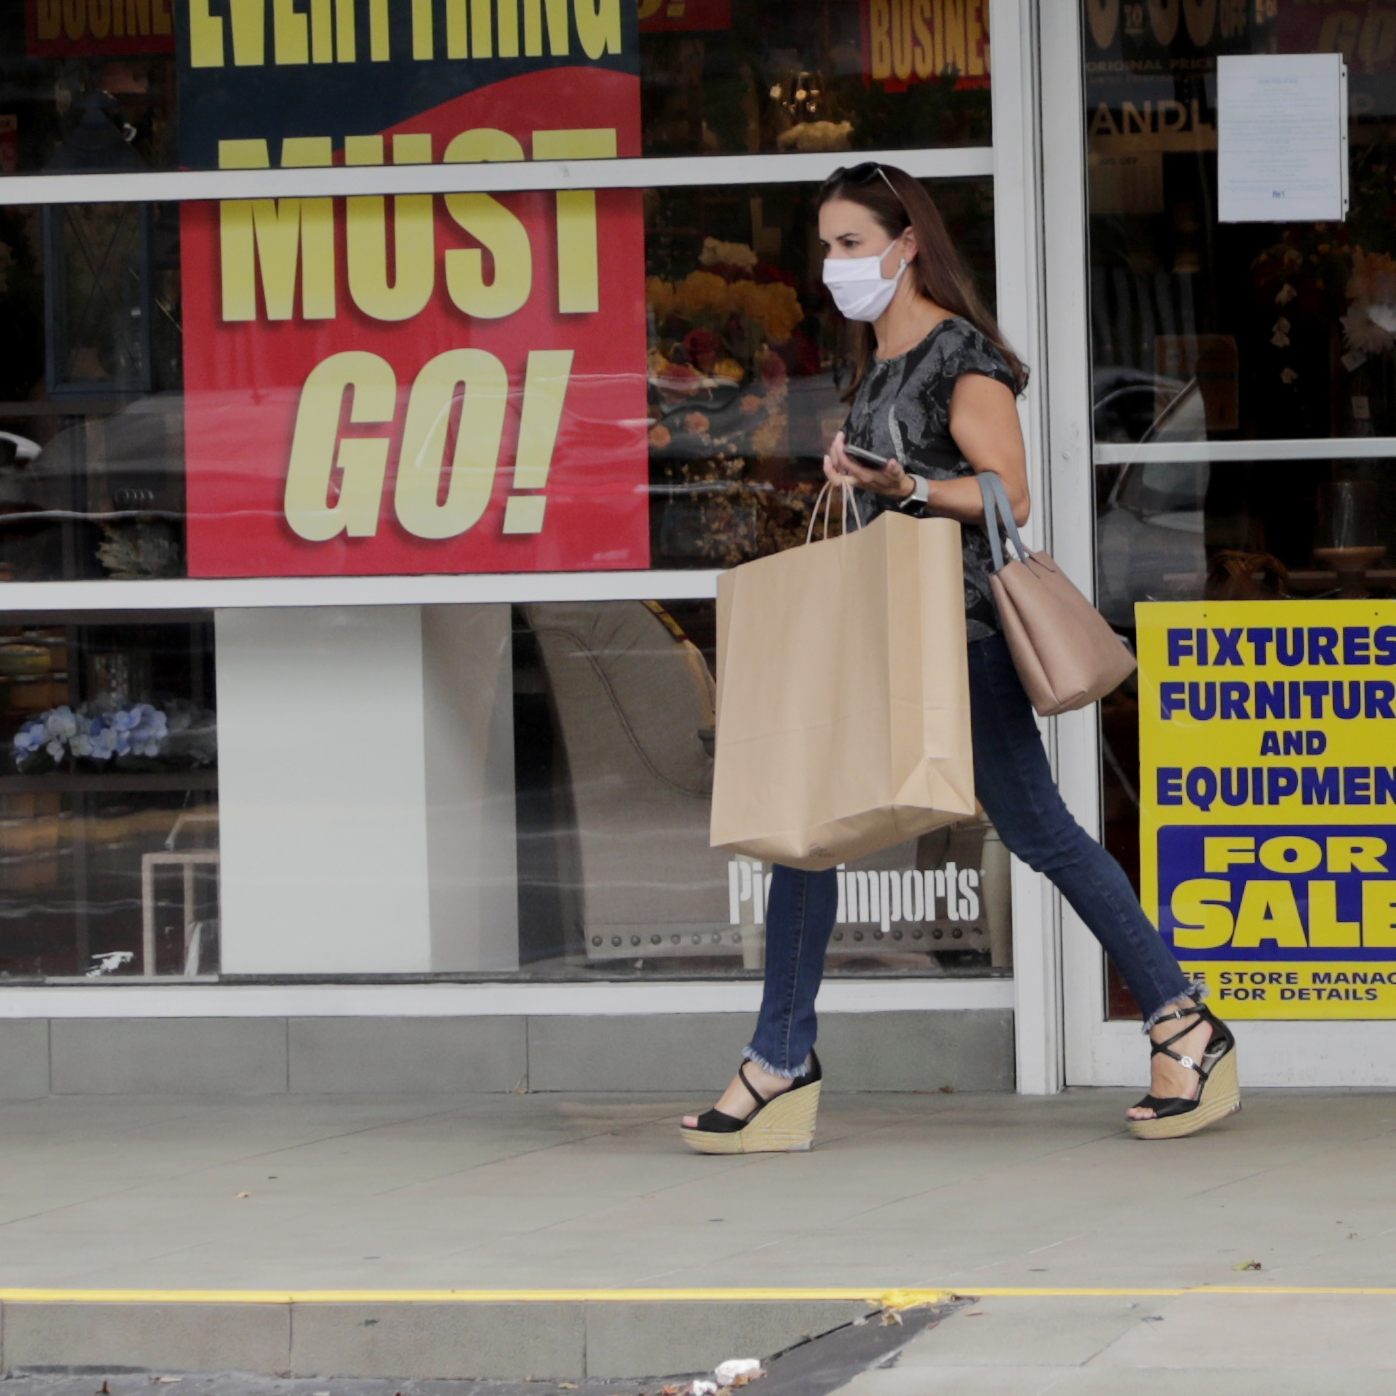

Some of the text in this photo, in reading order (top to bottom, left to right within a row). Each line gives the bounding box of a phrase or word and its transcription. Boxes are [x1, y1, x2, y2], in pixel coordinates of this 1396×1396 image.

[1088, 101, 1216, 137] ANDL
[217, 128, 617, 323] MUST
[283, 347, 576, 542] GO!
[1260, 730, 1327, 756] AND
[1204, 836, 1389, 873] FOR
[836, 861, 980, 933] imports
[1182, 971, 1206, 984] EE
[1219, 971, 1299, 985] STORE
[1219, 987, 1378, 1001] FOR DETAILS
